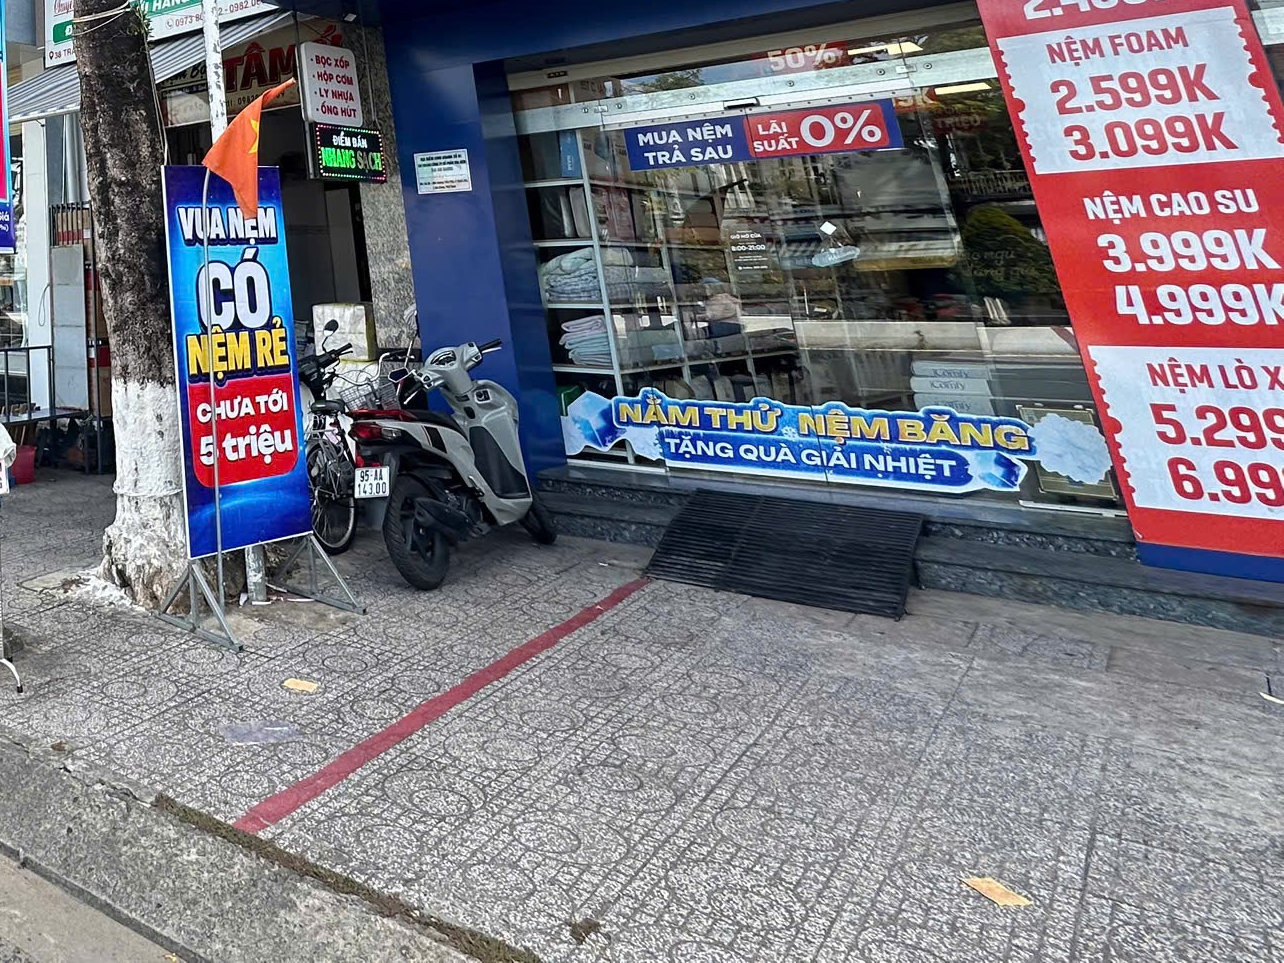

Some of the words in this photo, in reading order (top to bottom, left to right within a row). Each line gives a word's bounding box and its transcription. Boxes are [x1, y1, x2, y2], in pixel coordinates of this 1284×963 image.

[315, 54, 332, 69] BỌC
[335, 57, 350, 70] XỐP
[1046, 36, 1105, 66] NỆM
[1108, 26, 1189, 57] FOAM
[317, 72, 334, 86] HỘP
[336, 74, 353, 86] CƠM
[319, 88, 329, 98] LY
[331, 90, 354, 103] NHỰA
[1050, 63, 1221, 115] 2.599K
[321, 101, 339, 115] ỐNG
[341, 105, 357, 118] HÚT
[757, 120, 788, 136] LÃI
[637, 130, 683, 147] MUA
[687, 122, 733, 142] NỆM
[752, 136, 799, 153] SUẤT
[800, 109, 882, 148] 0%
[1063, 112, 1239, 161] 3.099K
[321, 147, 357, 169] NHANG
[357, 151, 382, 174] SẠCH
[644, 144, 686, 166] TRẢ
[690, 145, 734, 162] SAU
[178, 207, 226, 240] VUA
[1083, 190, 1147, 225] NỆM
[1150, 191, 1211, 216] CAO
[1214, 189, 1259, 213] SU
[1097, 228, 1282, 272] 3.999K
[199, 247, 272, 329] CÓ
[1115, 283, 1284, 326] 4.999K
[187, 326, 252, 379] NỆM
[255, 317, 289, 368] RẺ
[1146, 357, 1215, 394] NỆM
[1218, 358, 1258, 390] LÒ
[1261, 365, 1284, 391] X
[197, 396, 254, 423] CHƯA
[256, 388, 289, 414] TỚI
[619, 398, 700, 429] NẰM
[705, 404, 782, 432] THỬ
[799, 409, 892, 445] NỆM
[898, 415, 1030, 451] BĂNG
[200, 435, 217, 466] 5
[222, 425, 294, 465] triệu
[665, 435, 733, 459] TẶNG
[739, 443, 797, 464] QUÀ
[801, 444, 856, 469] GIẢI
[864, 452, 956, 480] NHIỆT
[1167, 457, 1284, 507] 6.99
